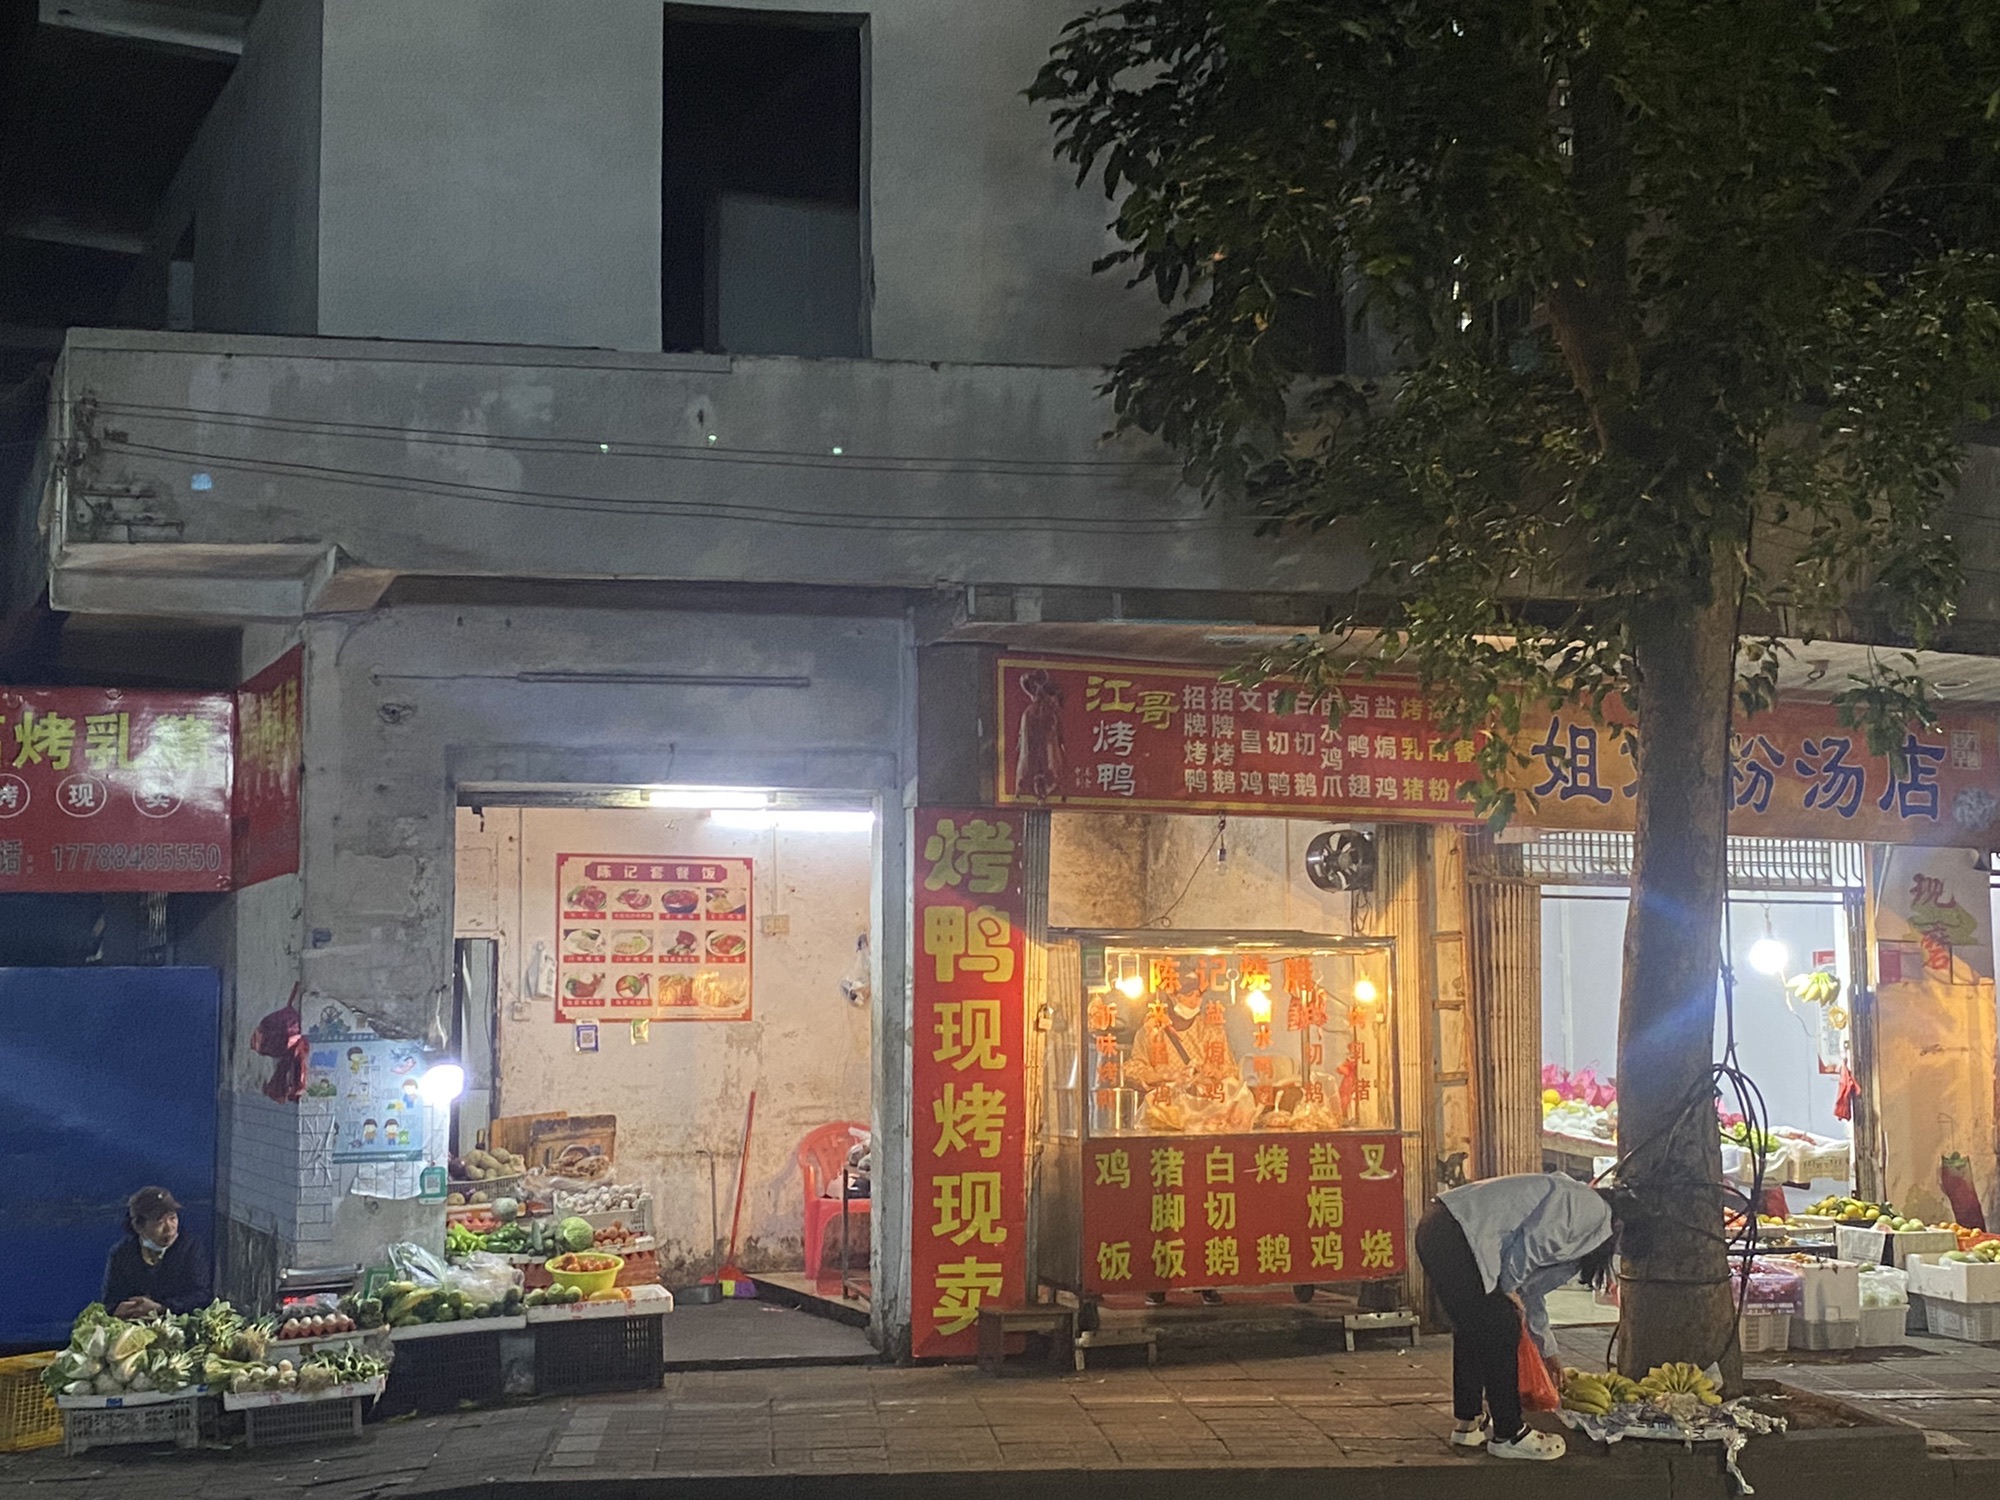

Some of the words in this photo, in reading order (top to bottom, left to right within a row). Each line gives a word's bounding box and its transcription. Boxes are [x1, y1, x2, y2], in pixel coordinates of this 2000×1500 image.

[0, 711, 211, 771] 烤乳猪
[1086, 675, 1180, 730] 江哥
[1182, 684, 1207, 793] 招牌烤鸭
[1210, 686, 1236, 794] 招牌烤鹅
[1239, 688, 1264, 796] 文昌鸡
[1294, 693, 1318, 798] 白切鹅
[1348, 694, 1371, 799] 卤鸭翅
[1374, 695, 1399, 800] 盐焗鸡
[1401, 698, 1424, 802] 烤乳猪
[1093, 720, 1137, 797] 烤鸭
[1531, 715, 1946, 822] 姐粉汤店
[1095, 1148, 1132, 1282] 鸡饭
[1150, 1147, 1187, 1280] 猪脚饭
[1204, 1146, 1239, 1277] 白切鹅
[1255, 1144, 1291, 1274] 烤鹅
[1307, 1142, 1344, 1272] 盐焗鸡
[1359, 1143, 1395, 1269] 叉烧
